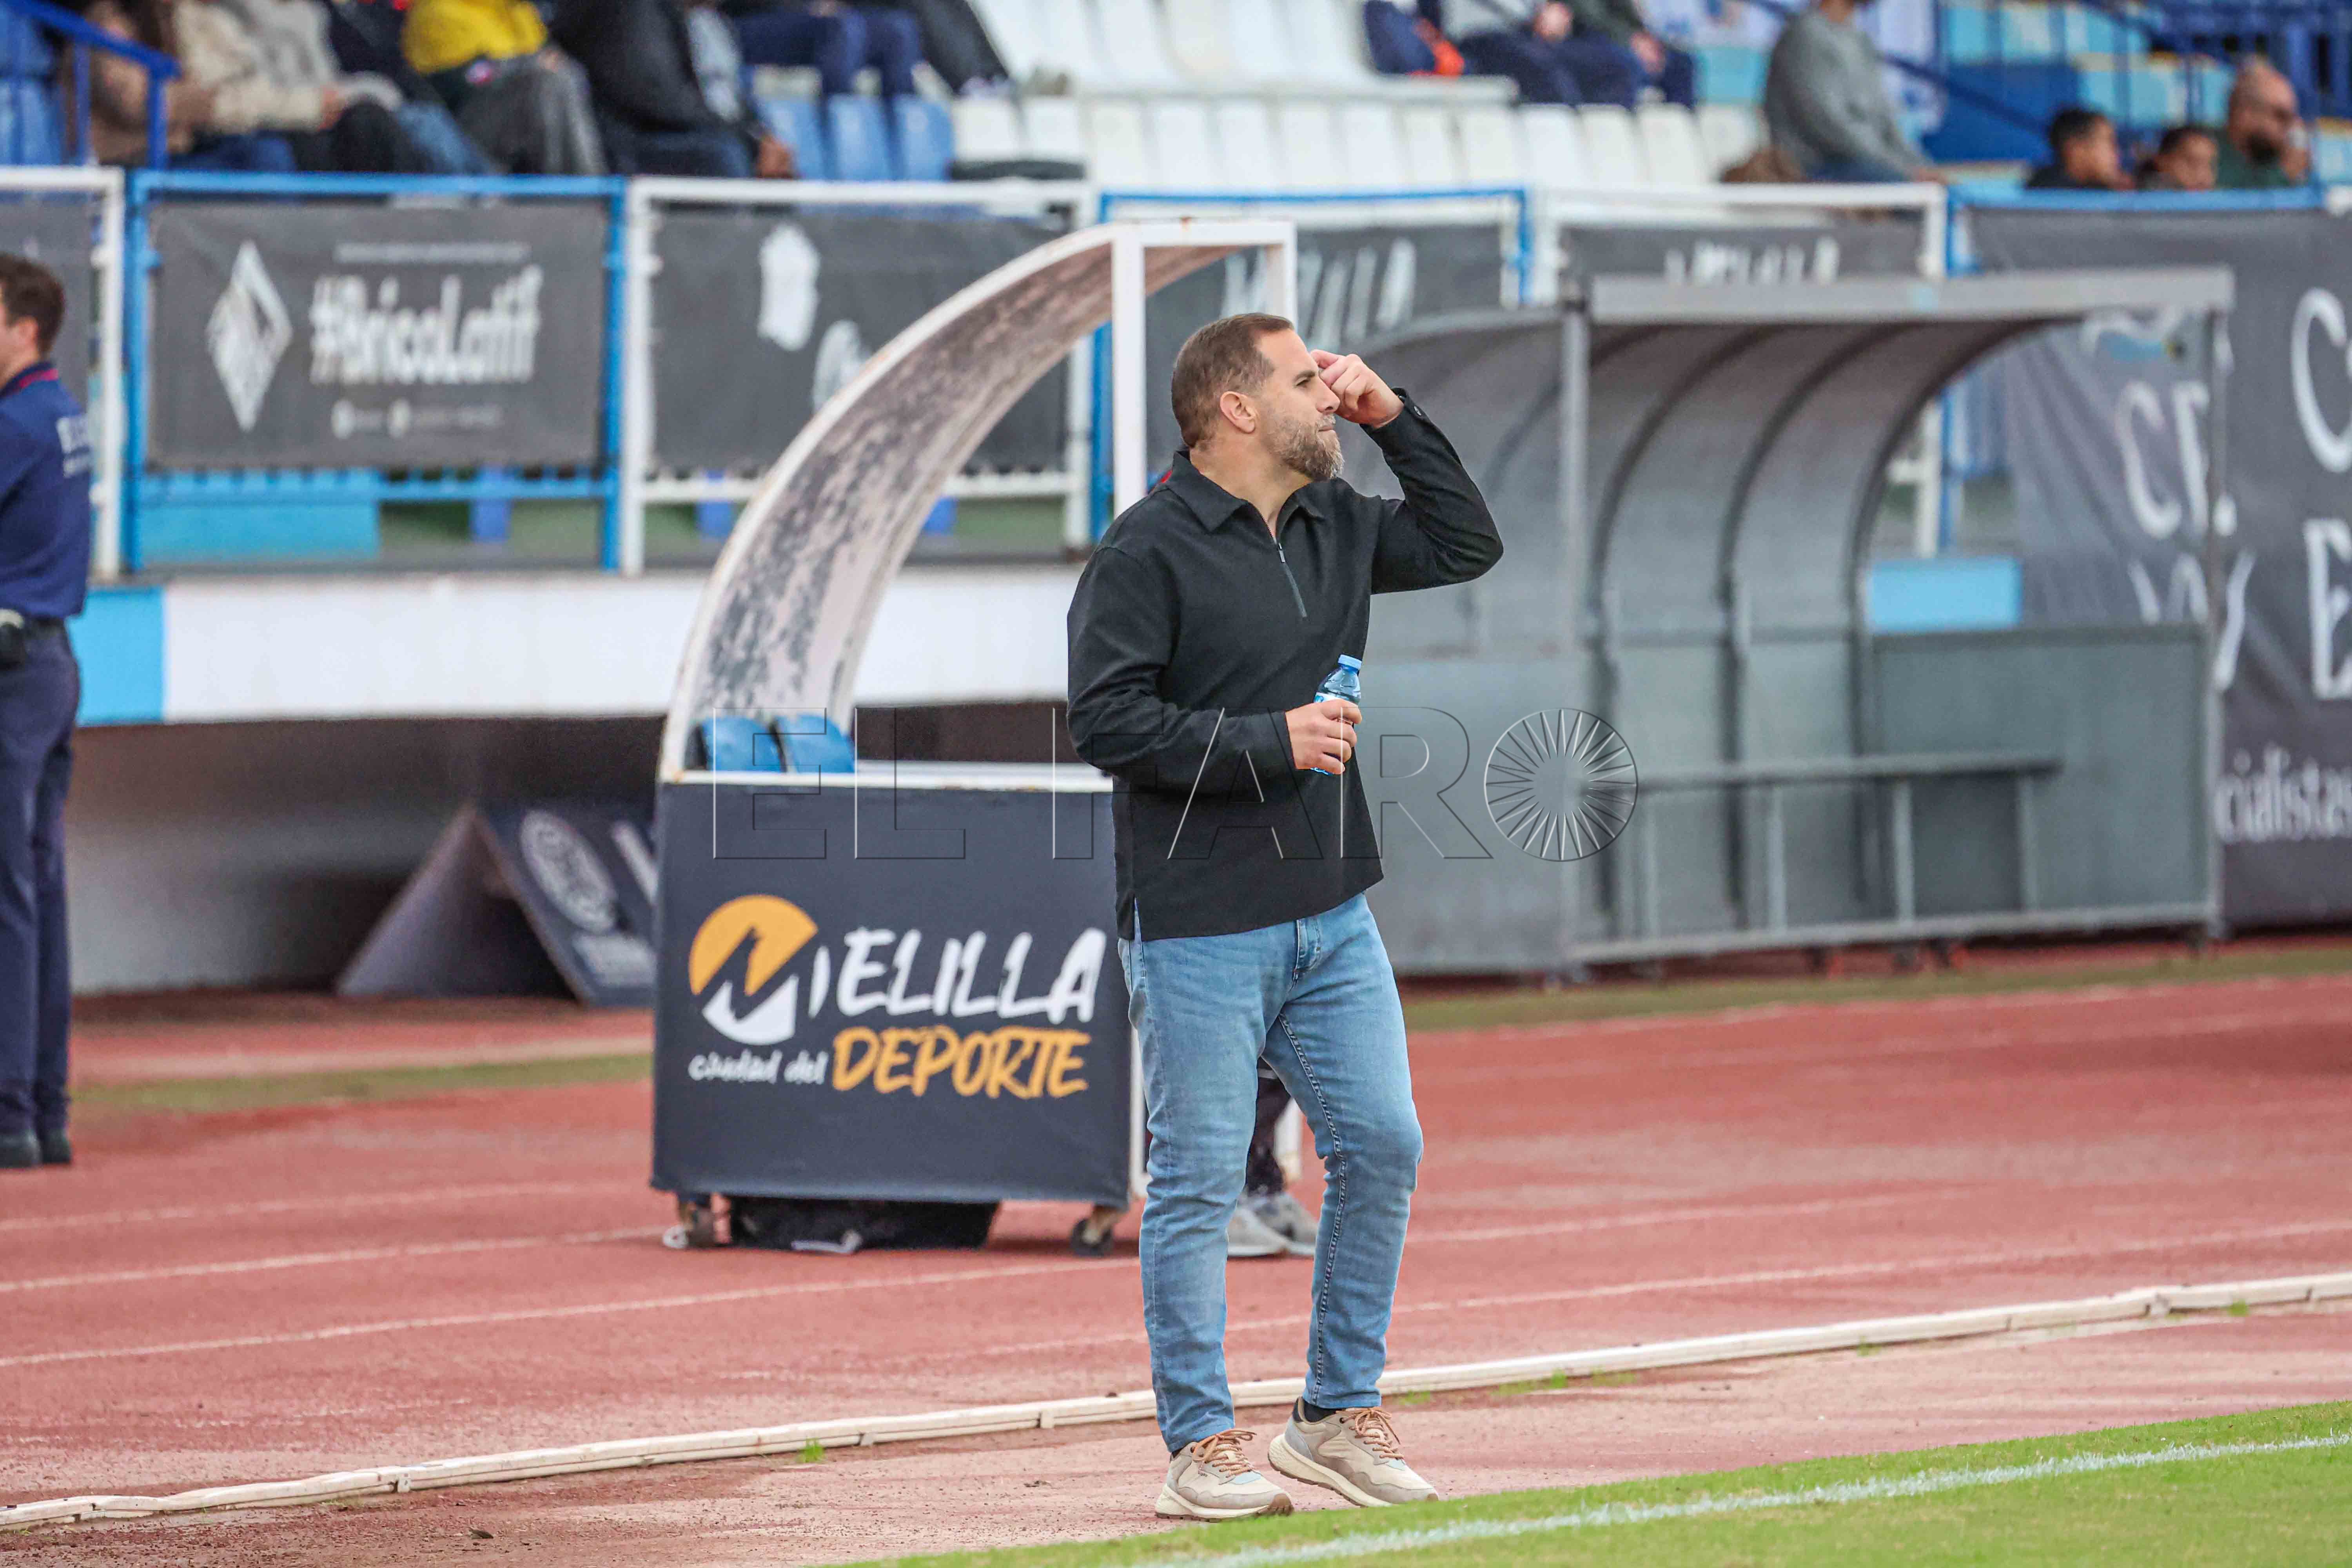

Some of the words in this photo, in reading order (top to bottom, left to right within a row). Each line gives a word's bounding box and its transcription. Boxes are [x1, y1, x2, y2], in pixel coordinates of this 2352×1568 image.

[688, 1048, 783, 1085] ciudad
[784, 1049, 829, 1085] del
[832, 1024, 1091, 1098] DEPORTE
